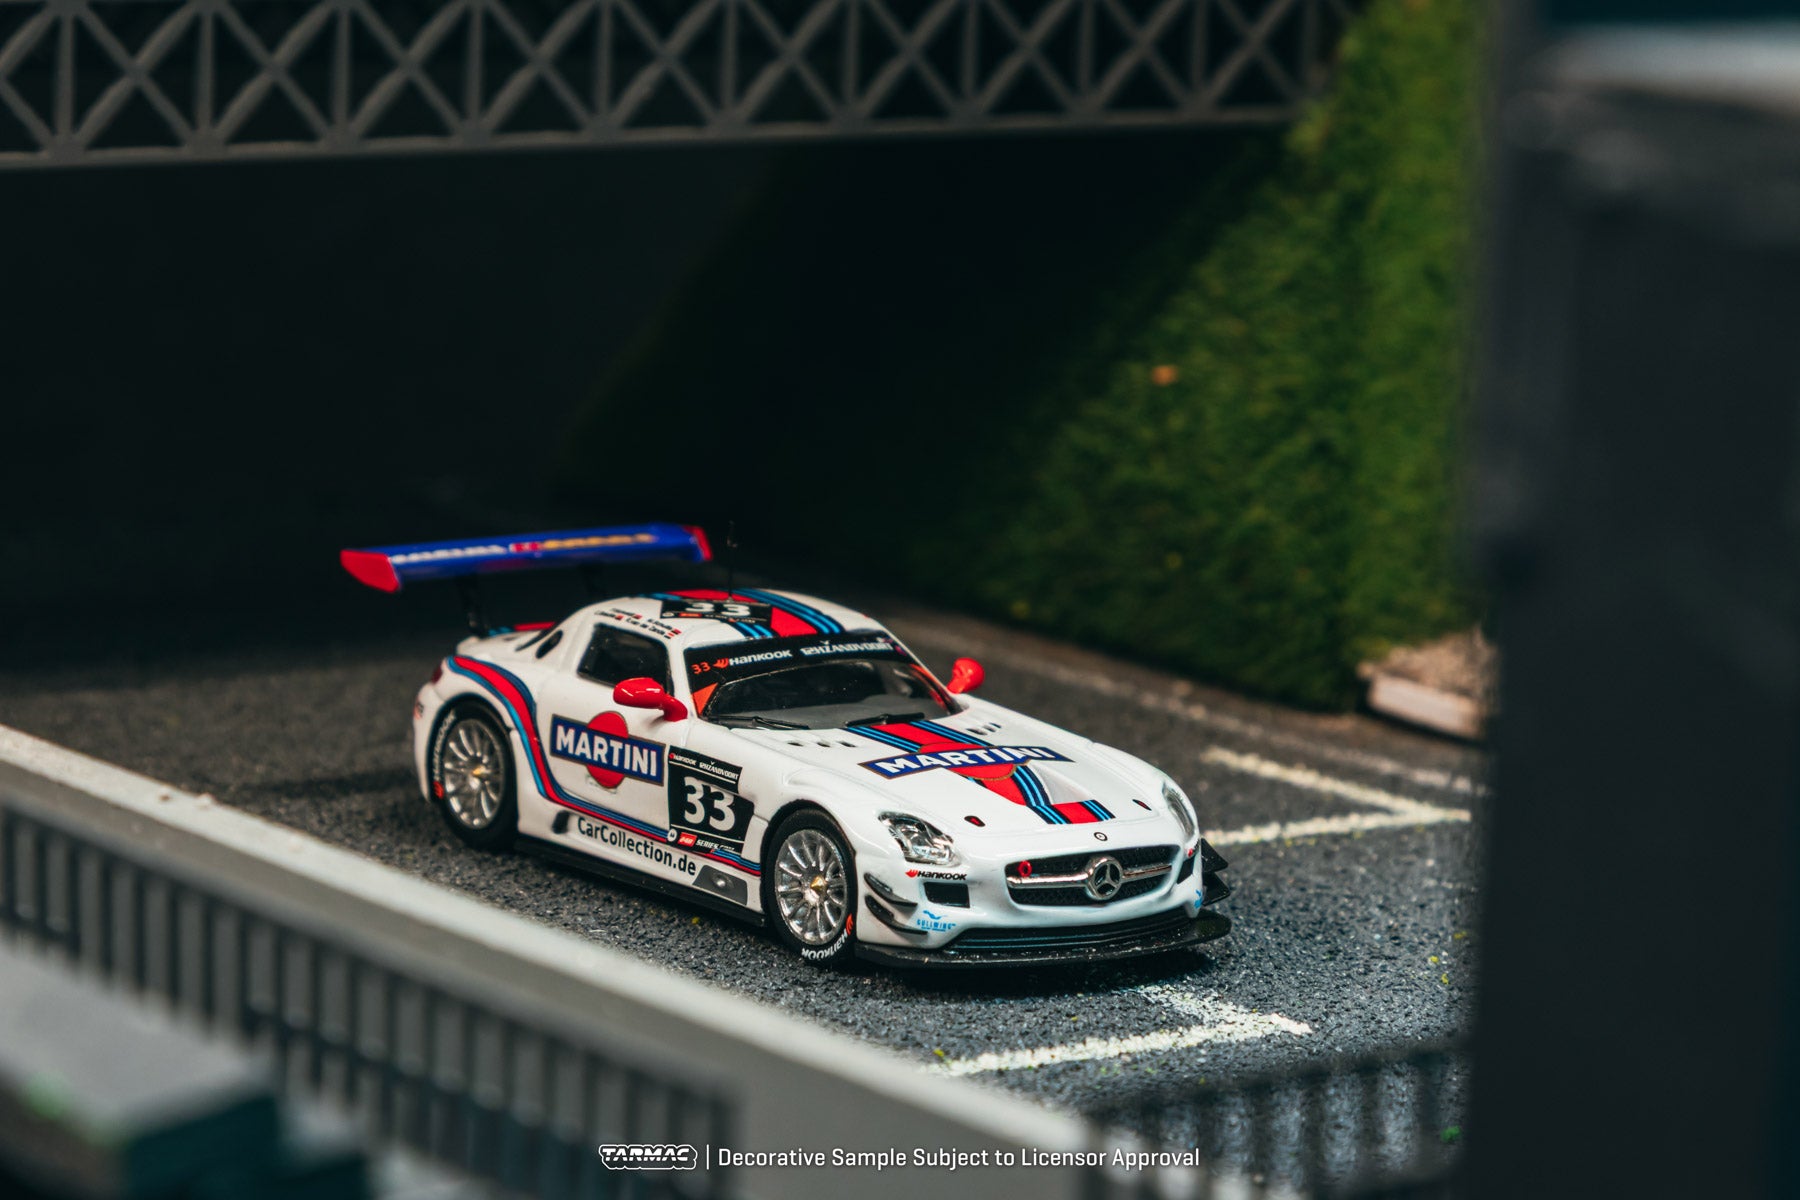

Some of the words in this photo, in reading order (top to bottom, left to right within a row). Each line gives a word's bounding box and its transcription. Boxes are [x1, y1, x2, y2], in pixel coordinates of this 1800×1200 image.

[685, 602, 750, 617] 33
[691, 661, 711, 675] 33
[556, 725, 657, 777] MARTINI
[875, 746, 1057, 774] MARTINI
[684, 776, 736, 831] 33
[578, 817, 697, 876] CarCollection.de
